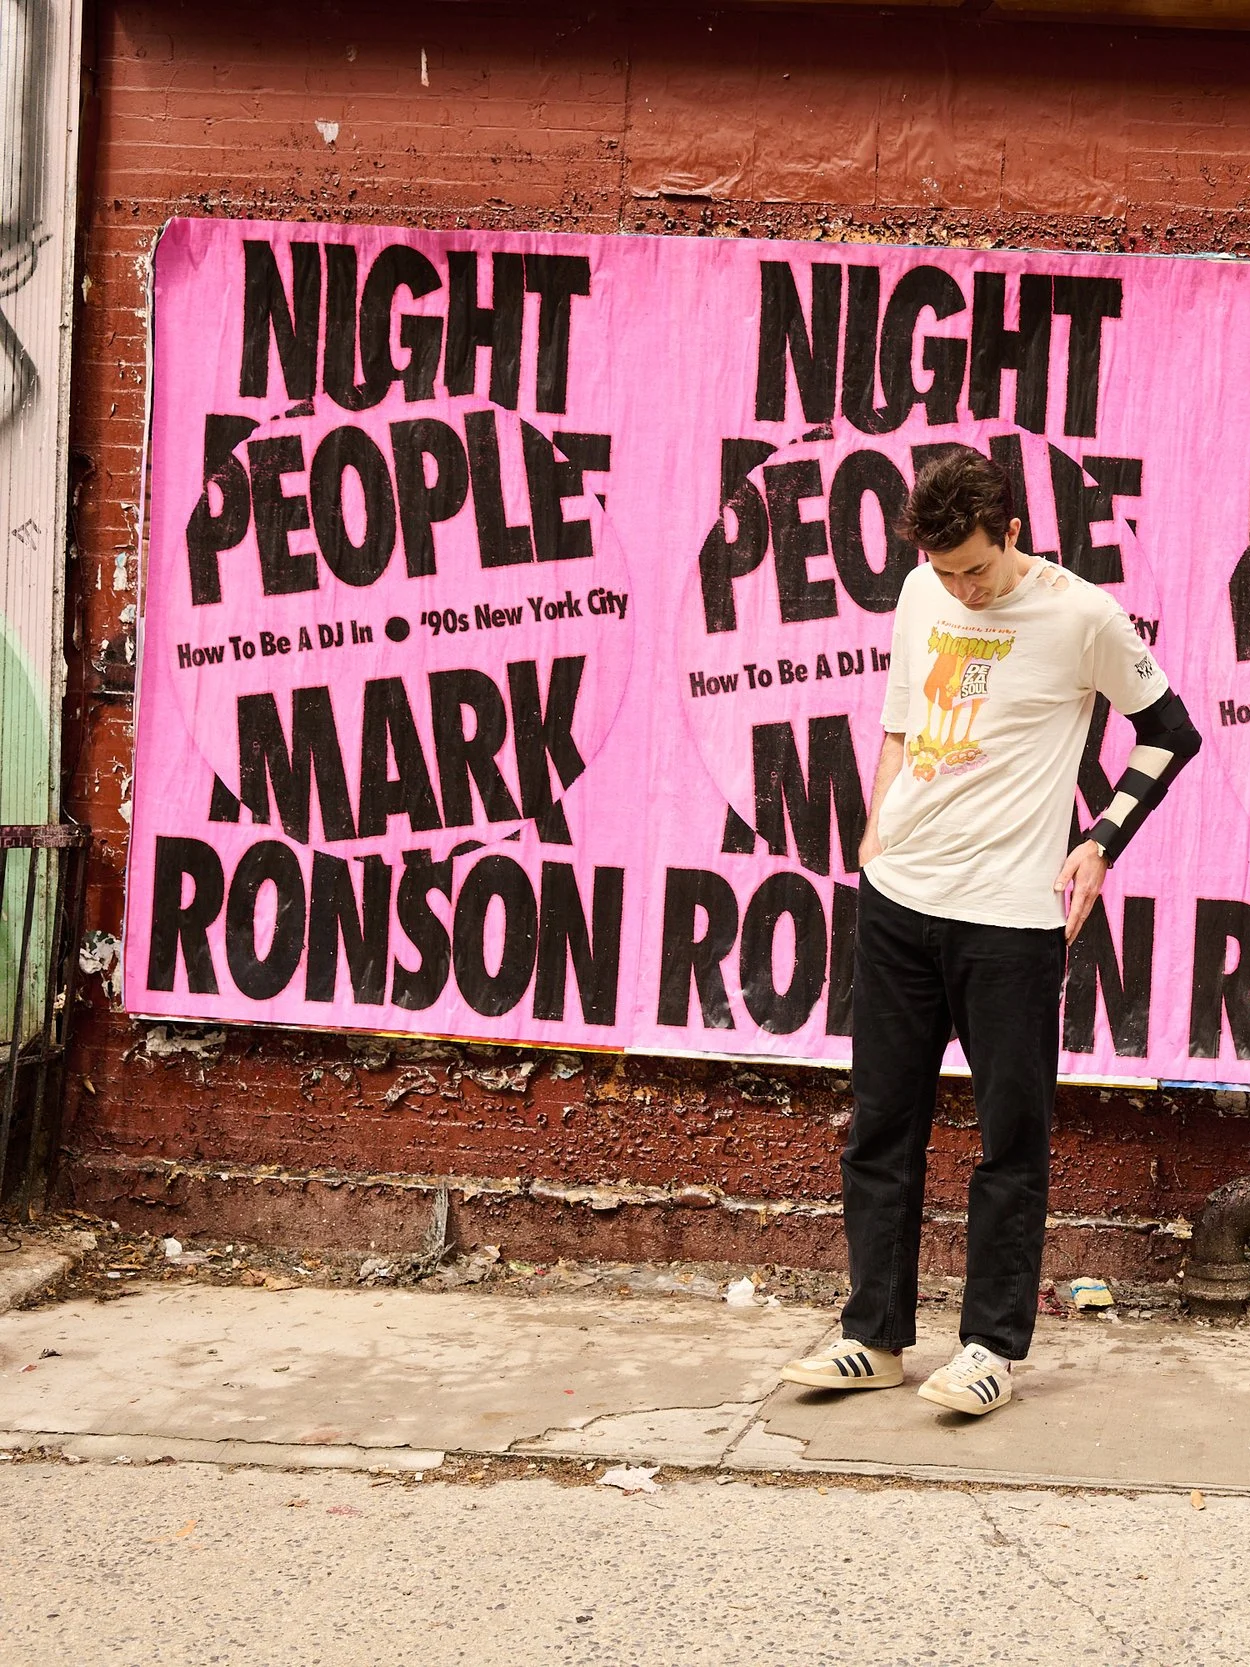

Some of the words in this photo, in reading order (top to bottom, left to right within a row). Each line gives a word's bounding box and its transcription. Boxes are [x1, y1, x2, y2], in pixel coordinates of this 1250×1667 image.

[238, 240, 590, 416] NIGHT
[755, 260, 1123, 441] NIGHT
[186, 410, 612, 606] PEOPLE
[699, 433, 1143, 634] PEOLE
[177, 643, 225, 669] How
[229, 635, 255, 661] To
[259, 631, 291, 657] Be
[298, 626, 313, 651] A
[318, 621, 344, 649] DJ
[351, 620, 373, 644] In
[420, 608, 469, 636] '90s
[474, 604, 523, 630] New
[527, 590, 583, 622] York
[587, 587, 629, 620] City
[689, 672, 739, 698] How
[744, 664, 773, 689] To
[778, 659, 808, 685] Be
[816, 653, 832, 680] A
[837, 648, 865, 677] DJ
[961, 683, 988, 697] SOUL
[967, 664, 990, 674] DE
[209, 655, 586, 846] MARK
[147, 836, 625, 1027] RONSON
